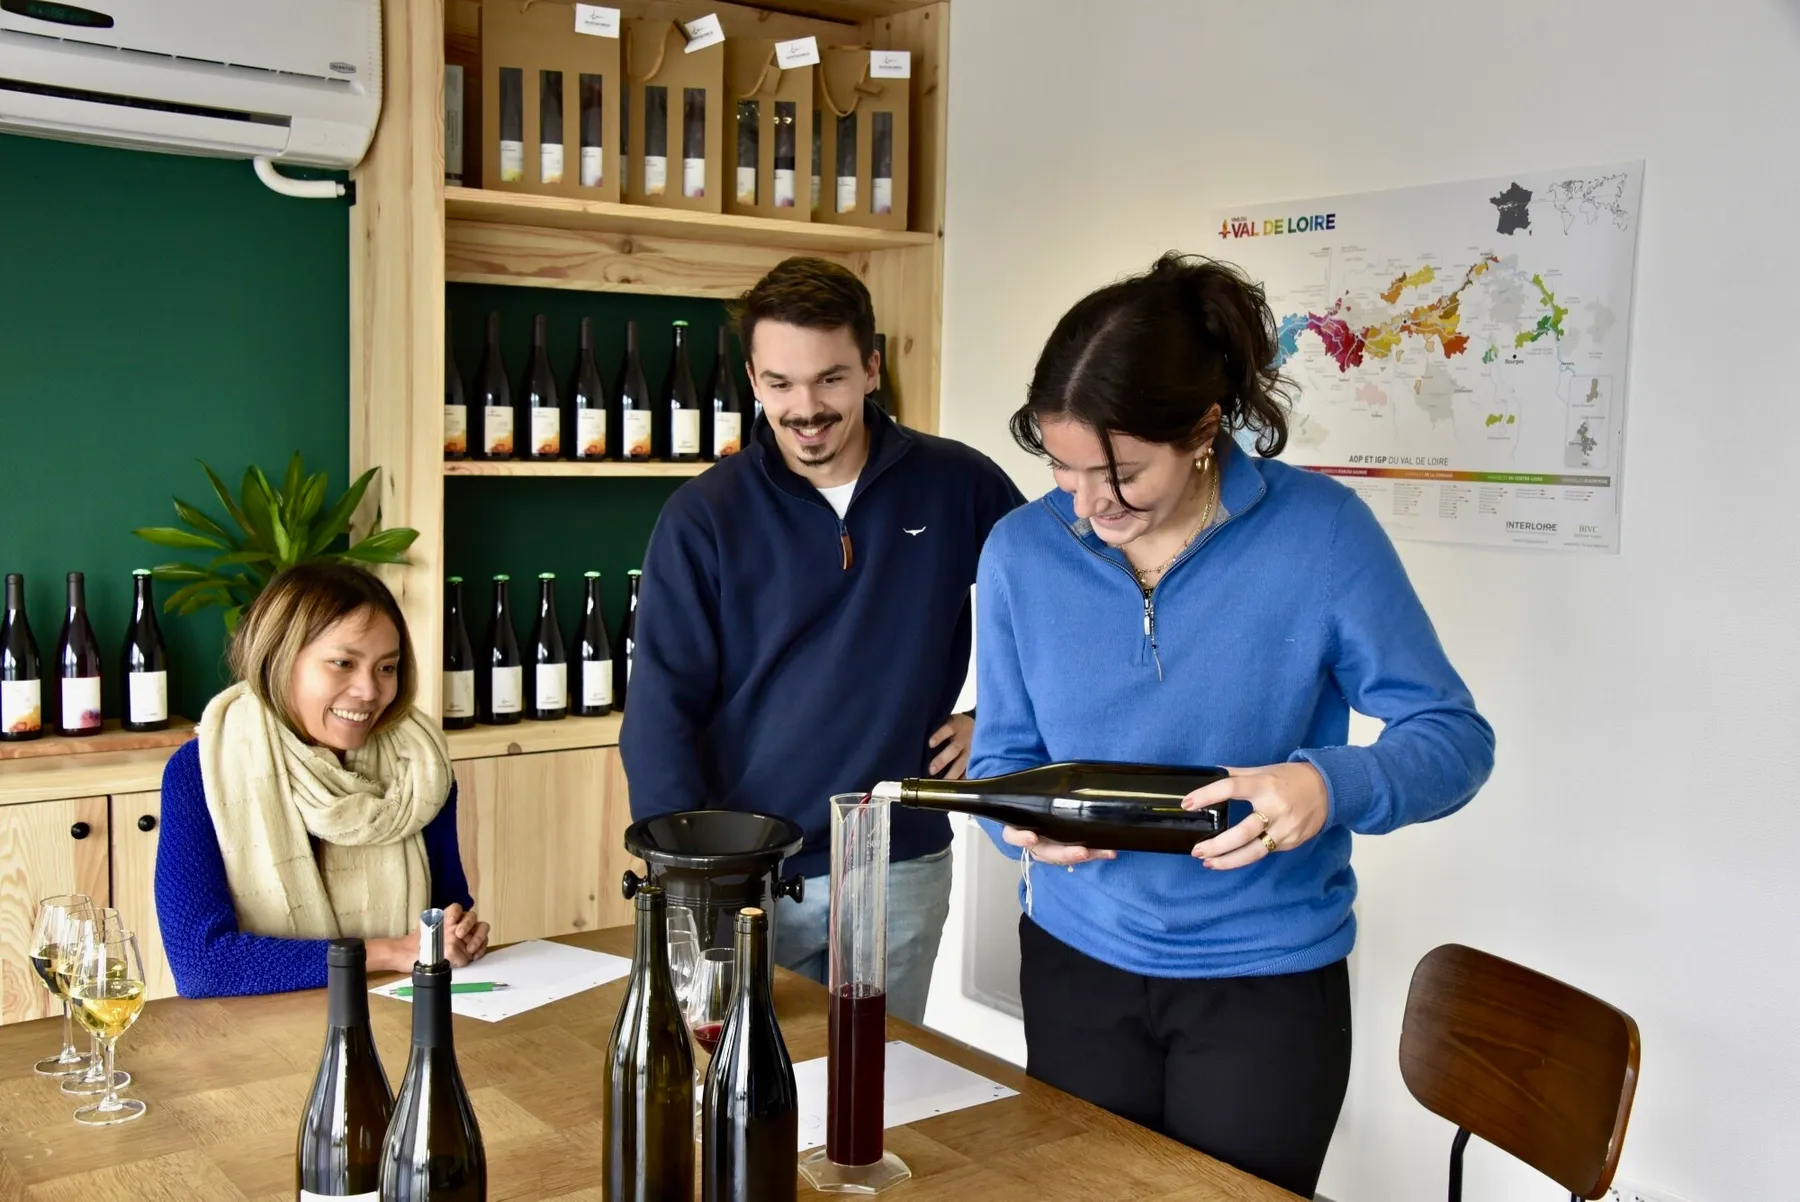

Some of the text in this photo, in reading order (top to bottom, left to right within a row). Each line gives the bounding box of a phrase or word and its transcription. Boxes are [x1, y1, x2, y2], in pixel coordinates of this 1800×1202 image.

[1231, 213, 1336, 238] VAL DE LOIRE
[1349, 455, 1449, 466] AOP ET IGP DU VAL DE LOIRE
[1506, 521, 1557, 532] INTERLOIRE
[1579, 525, 1598, 533] BIVC
